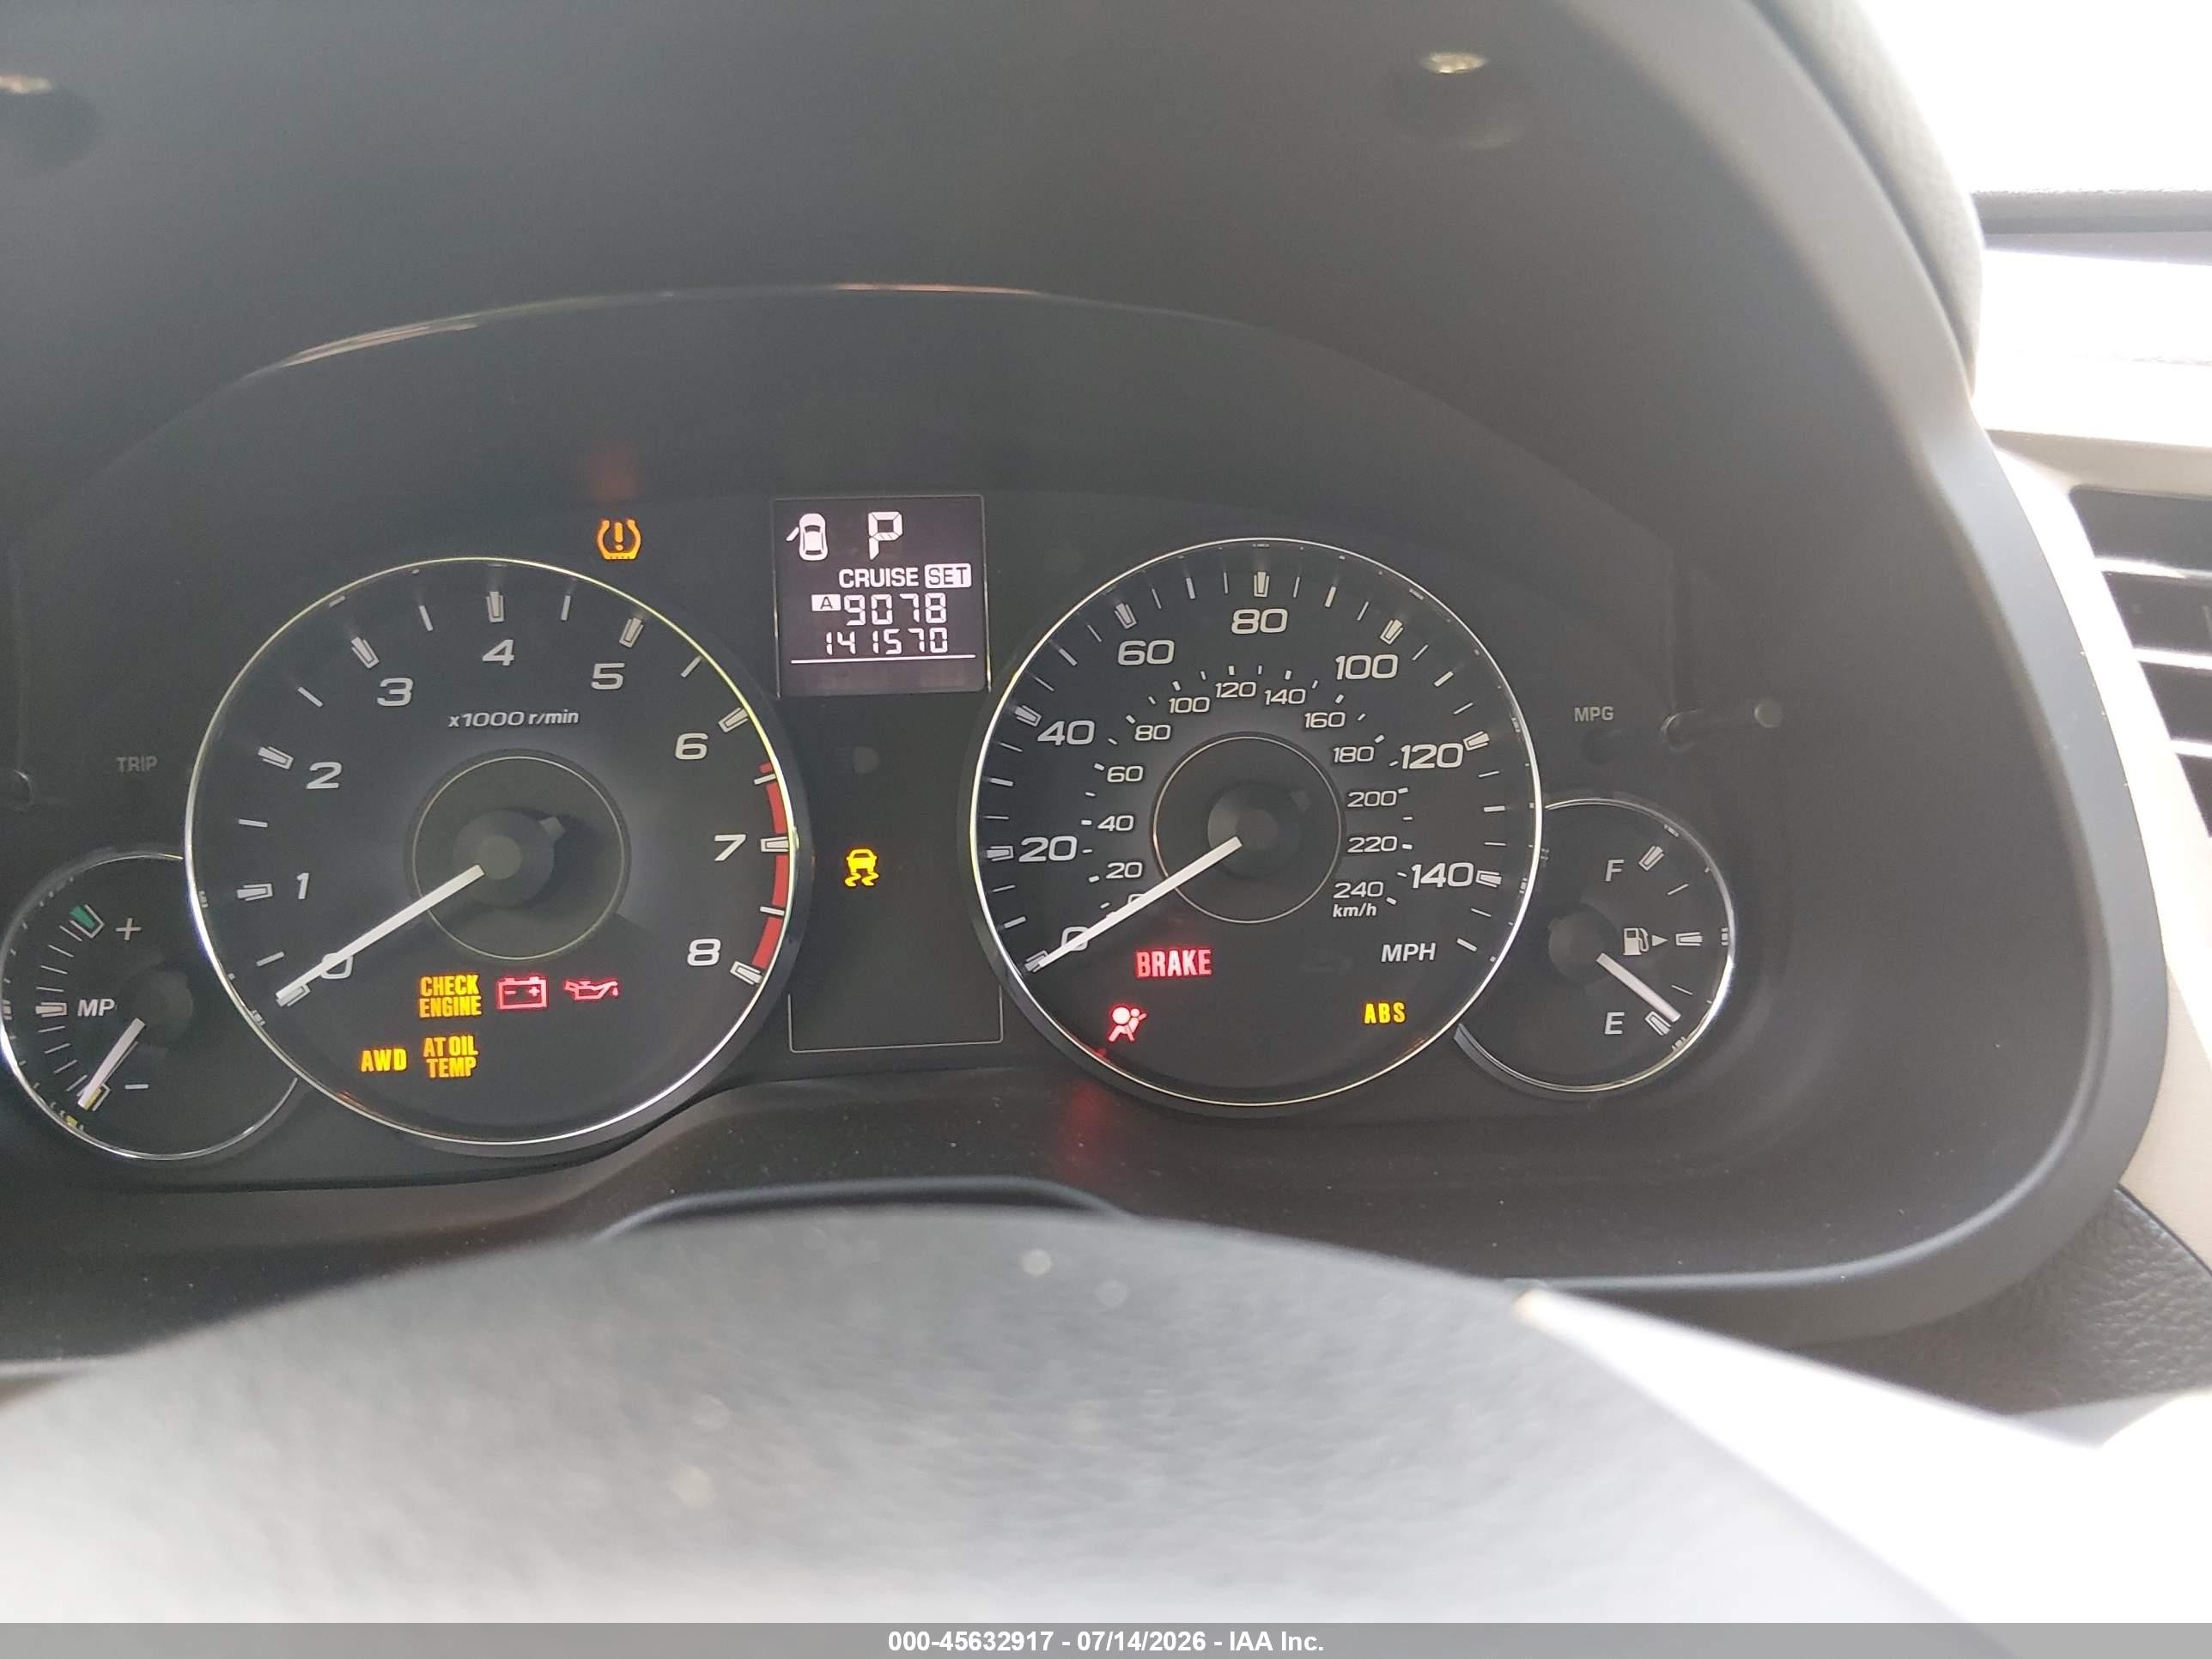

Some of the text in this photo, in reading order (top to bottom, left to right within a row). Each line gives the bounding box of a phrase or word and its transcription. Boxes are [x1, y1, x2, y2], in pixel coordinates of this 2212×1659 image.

[868, 512, 902, 559] P
[839, 567, 967, 588] CRUISE SET
[844, 592, 946, 625] 9078
[1231, 609, 1287, 634] 80
[483, 640, 514, 665] 4
[826, 628, 948, 655] 141570
[1118, 640, 1174, 665] 60
[592, 663, 624, 690] 5
[1336, 654, 1398, 679] 100
[377, 678, 413, 706] 3
[1216, 682, 1256, 697] 120
[1265, 689, 1305, 705] 140
[1170, 697, 1210, 713] 100
[1575, 707, 1613, 721] MPG
[448, 709, 578, 726] x1000 r/min
[1305, 712, 1346, 727] 160
[1037, 720, 1094, 745] 40
[1134, 724, 1170, 740] 80
[676, 733, 708, 759] 6
[1334, 746, 1374, 763] 180
[1401, 744, 1462, 769] 120
[117, 756, 157, 772] TRIP
[1106, 766, 1143, 782] 60
[307, 763, 341, 789] 2
[1347, 791, 1396, 807] 200
[1098, 816, 1133, 831] 40
[714, 835, 745, 860] 7
[1019, 836, 1077, 861] 20
[1348, 836, 1397, 852] 220
[1106, 862, 1142, 878] 20
[1412, 863, 1474, 888] 140
[1606, 860, 1624, 881] F
[297, 873, 309, 899] 1
[1334, 882, 1383, 898] 240
[1333, 902, 1376, 917] km/h
[688, 939, 720, 965] 8
[1138, 950, 1210, 976] BRAKE
[1382, 943, 1436, 962] MPH
[421, 975, 480, 996] CHECK
[77, 998, 118, 1017] MP
[420, 996, 482, 1018] ENGINE
[1364, 1002, 1405, 1024] ABS
[1605, 1012, 1625, 1034] E
[423, 1036, 478, 1057] AT OIL
[362, 1048, 406, 1072] AWD
[426, 1056, 477, 1079] TEMP
